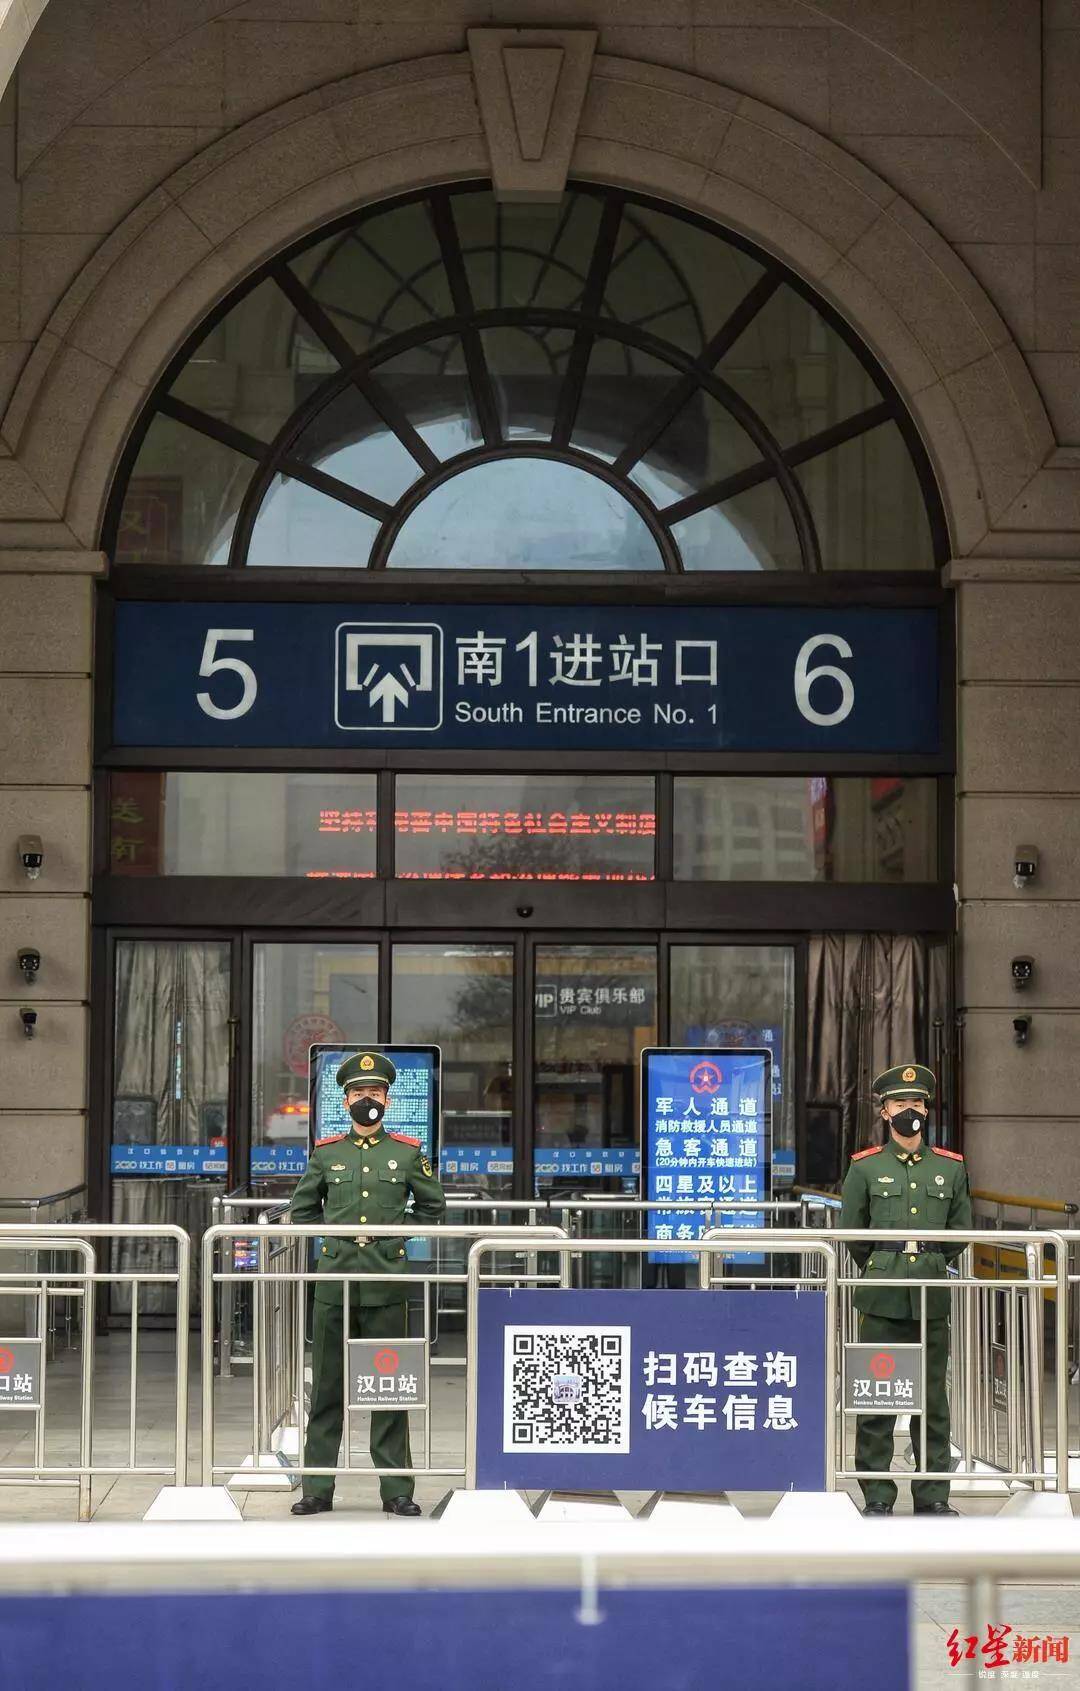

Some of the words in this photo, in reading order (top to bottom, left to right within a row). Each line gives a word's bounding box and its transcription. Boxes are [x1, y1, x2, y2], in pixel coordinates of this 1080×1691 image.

[455, 630, 718, 687] 南1进站口
[196, 629, 258, 720] 5
[794, 634, 855, 727] 6
[455, 702, 523, 723] South
[536, 702, 642, 724] Entrance
[654, 704, 695, 724] No.
[707, 704, 718, 724] 1
[560, 987, 645, 1004] 贵宾俱乐部
[560, 1006, 576, 1014] VIP
[580, 1006, 601, 1015] Club
[655, 1097, 757, 1116] 军人通道
[655, 1119, 757, 1133] 消防救援人员通道
[655, 1138, 757, 1156] 急客通道
[655, 1175, 758, 1193] 四星及以上
[643, 1351, 798, 1388] 扫码查询
[357, 1374, 418, 1394] 汉口站
[853, 1379, 914, 1398] 汉口站
[641, 1394, 799, 1431] 候车信息
